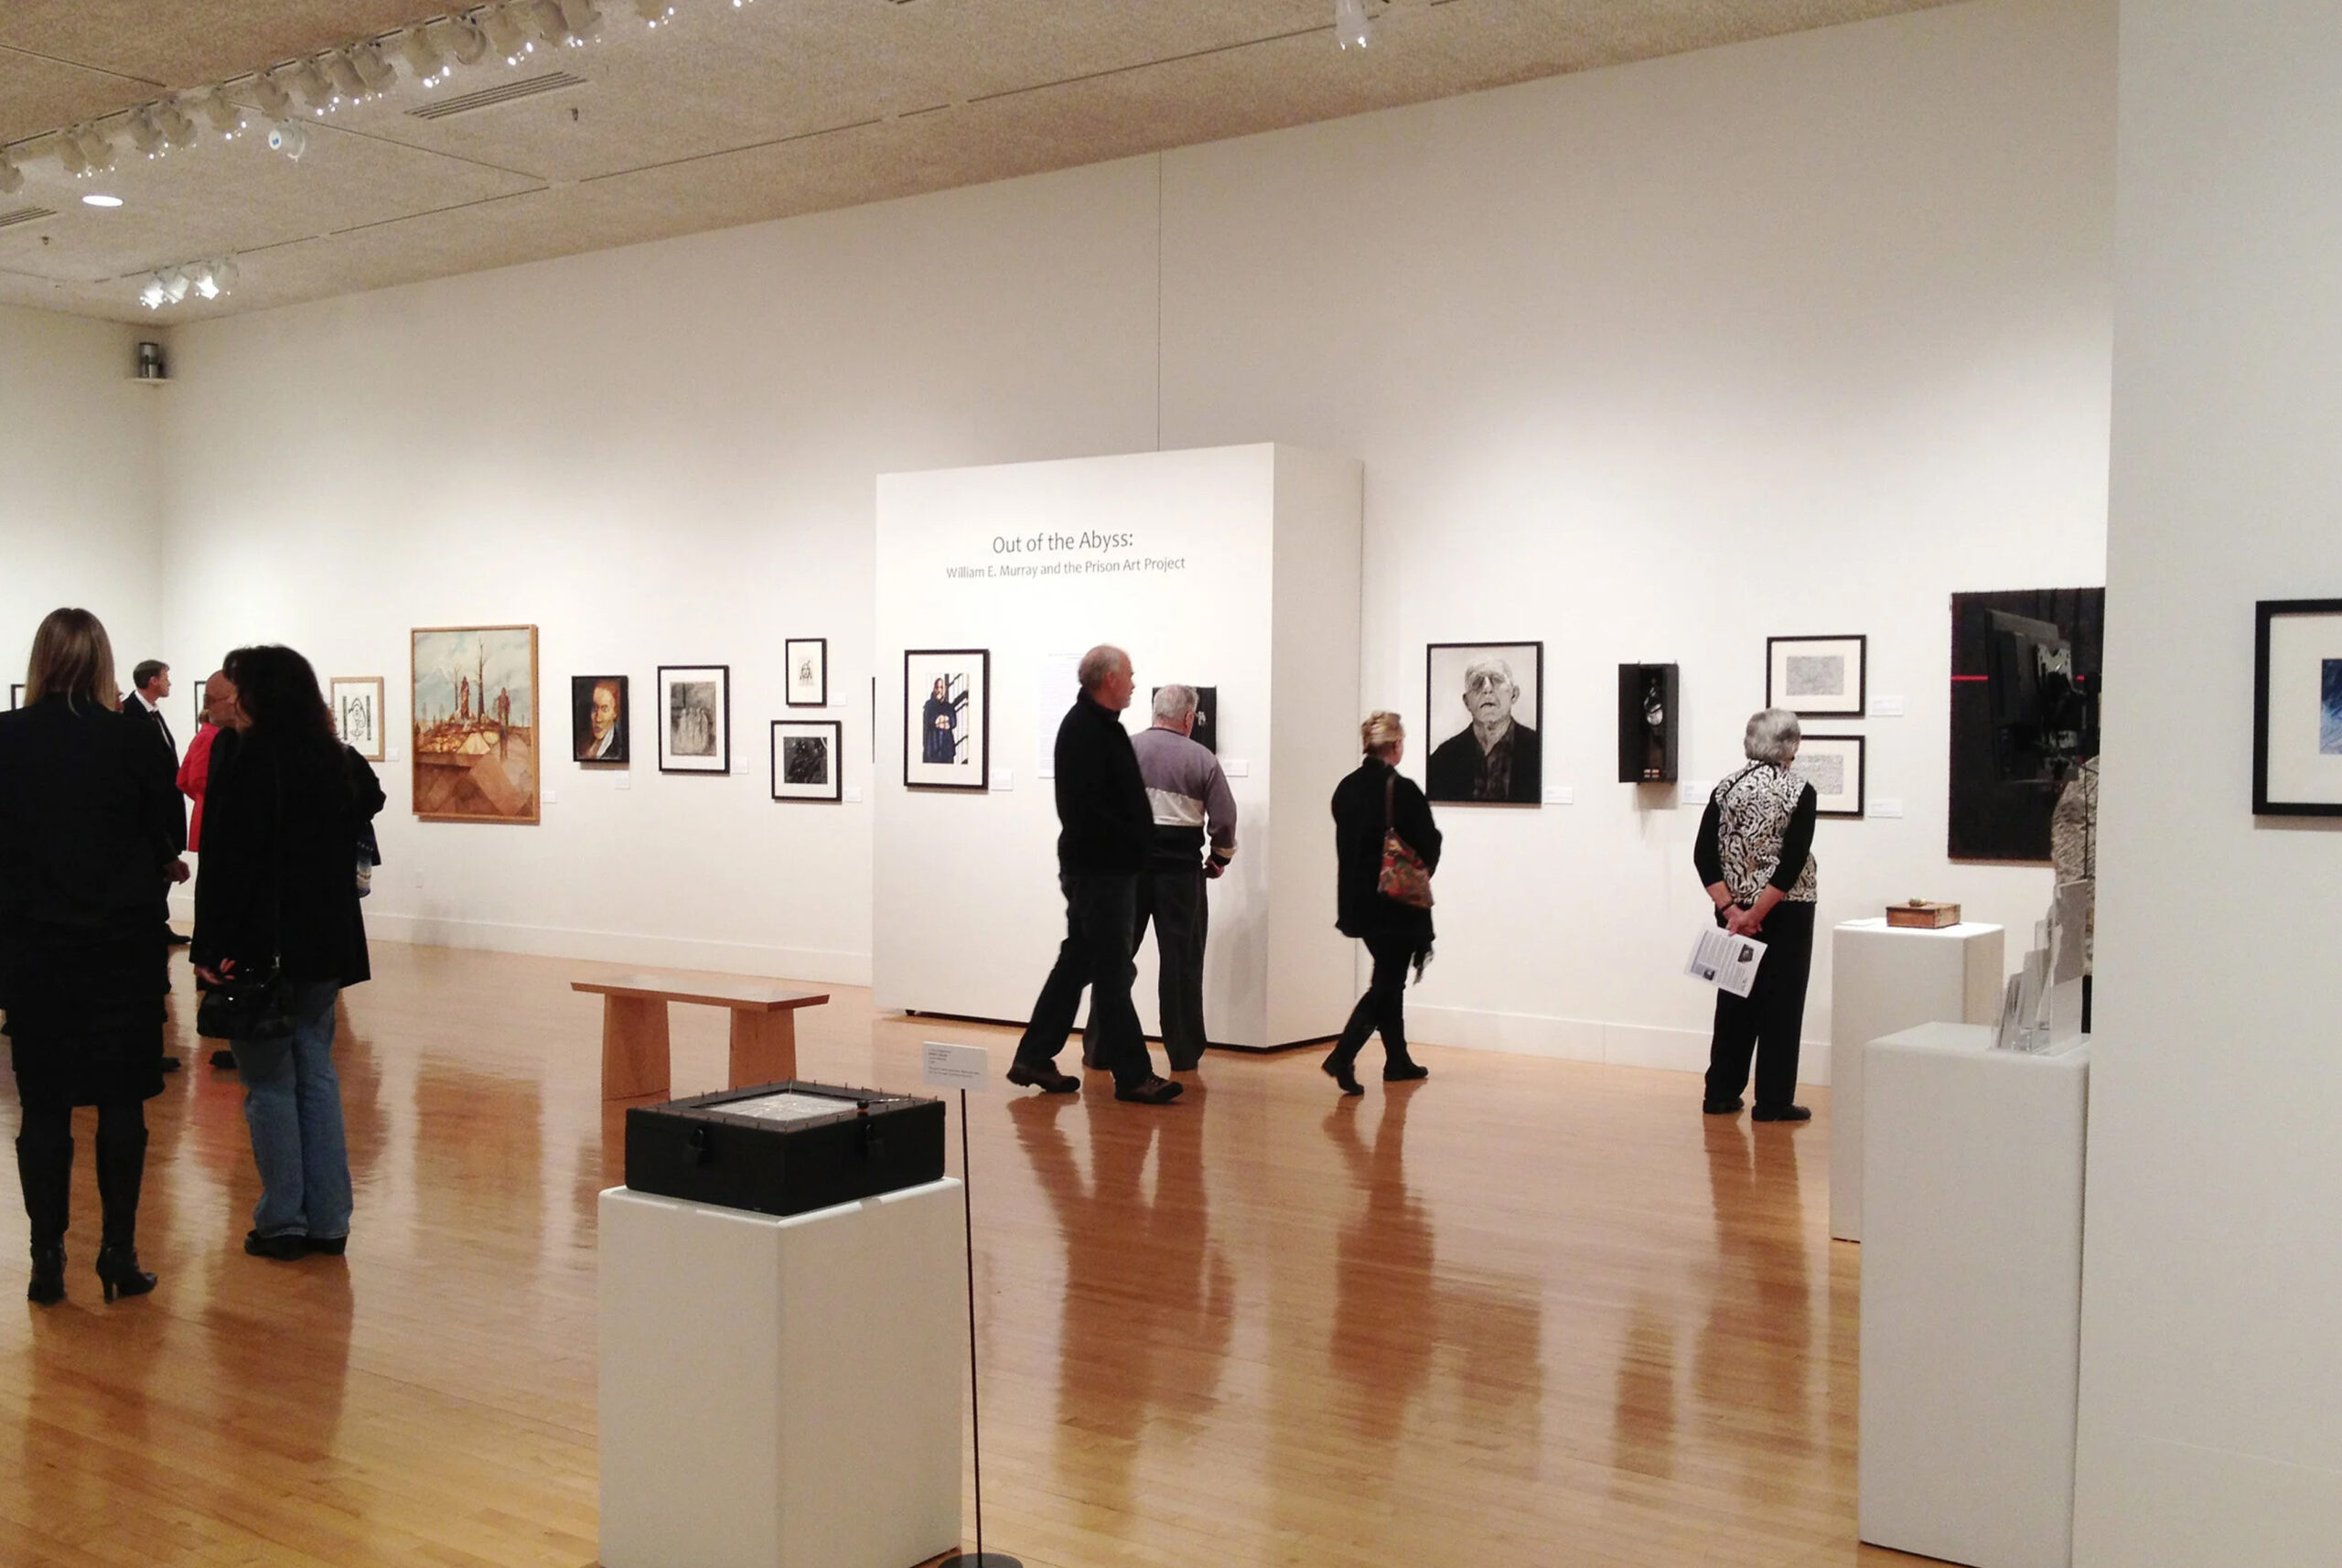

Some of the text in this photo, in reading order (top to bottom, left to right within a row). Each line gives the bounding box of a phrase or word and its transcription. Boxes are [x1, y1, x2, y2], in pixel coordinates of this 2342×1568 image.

[993, 530, 1133, 553] Out of the Abyss:
[946, 557, 1186, 578] William E. Murray and the Prison Art Project
